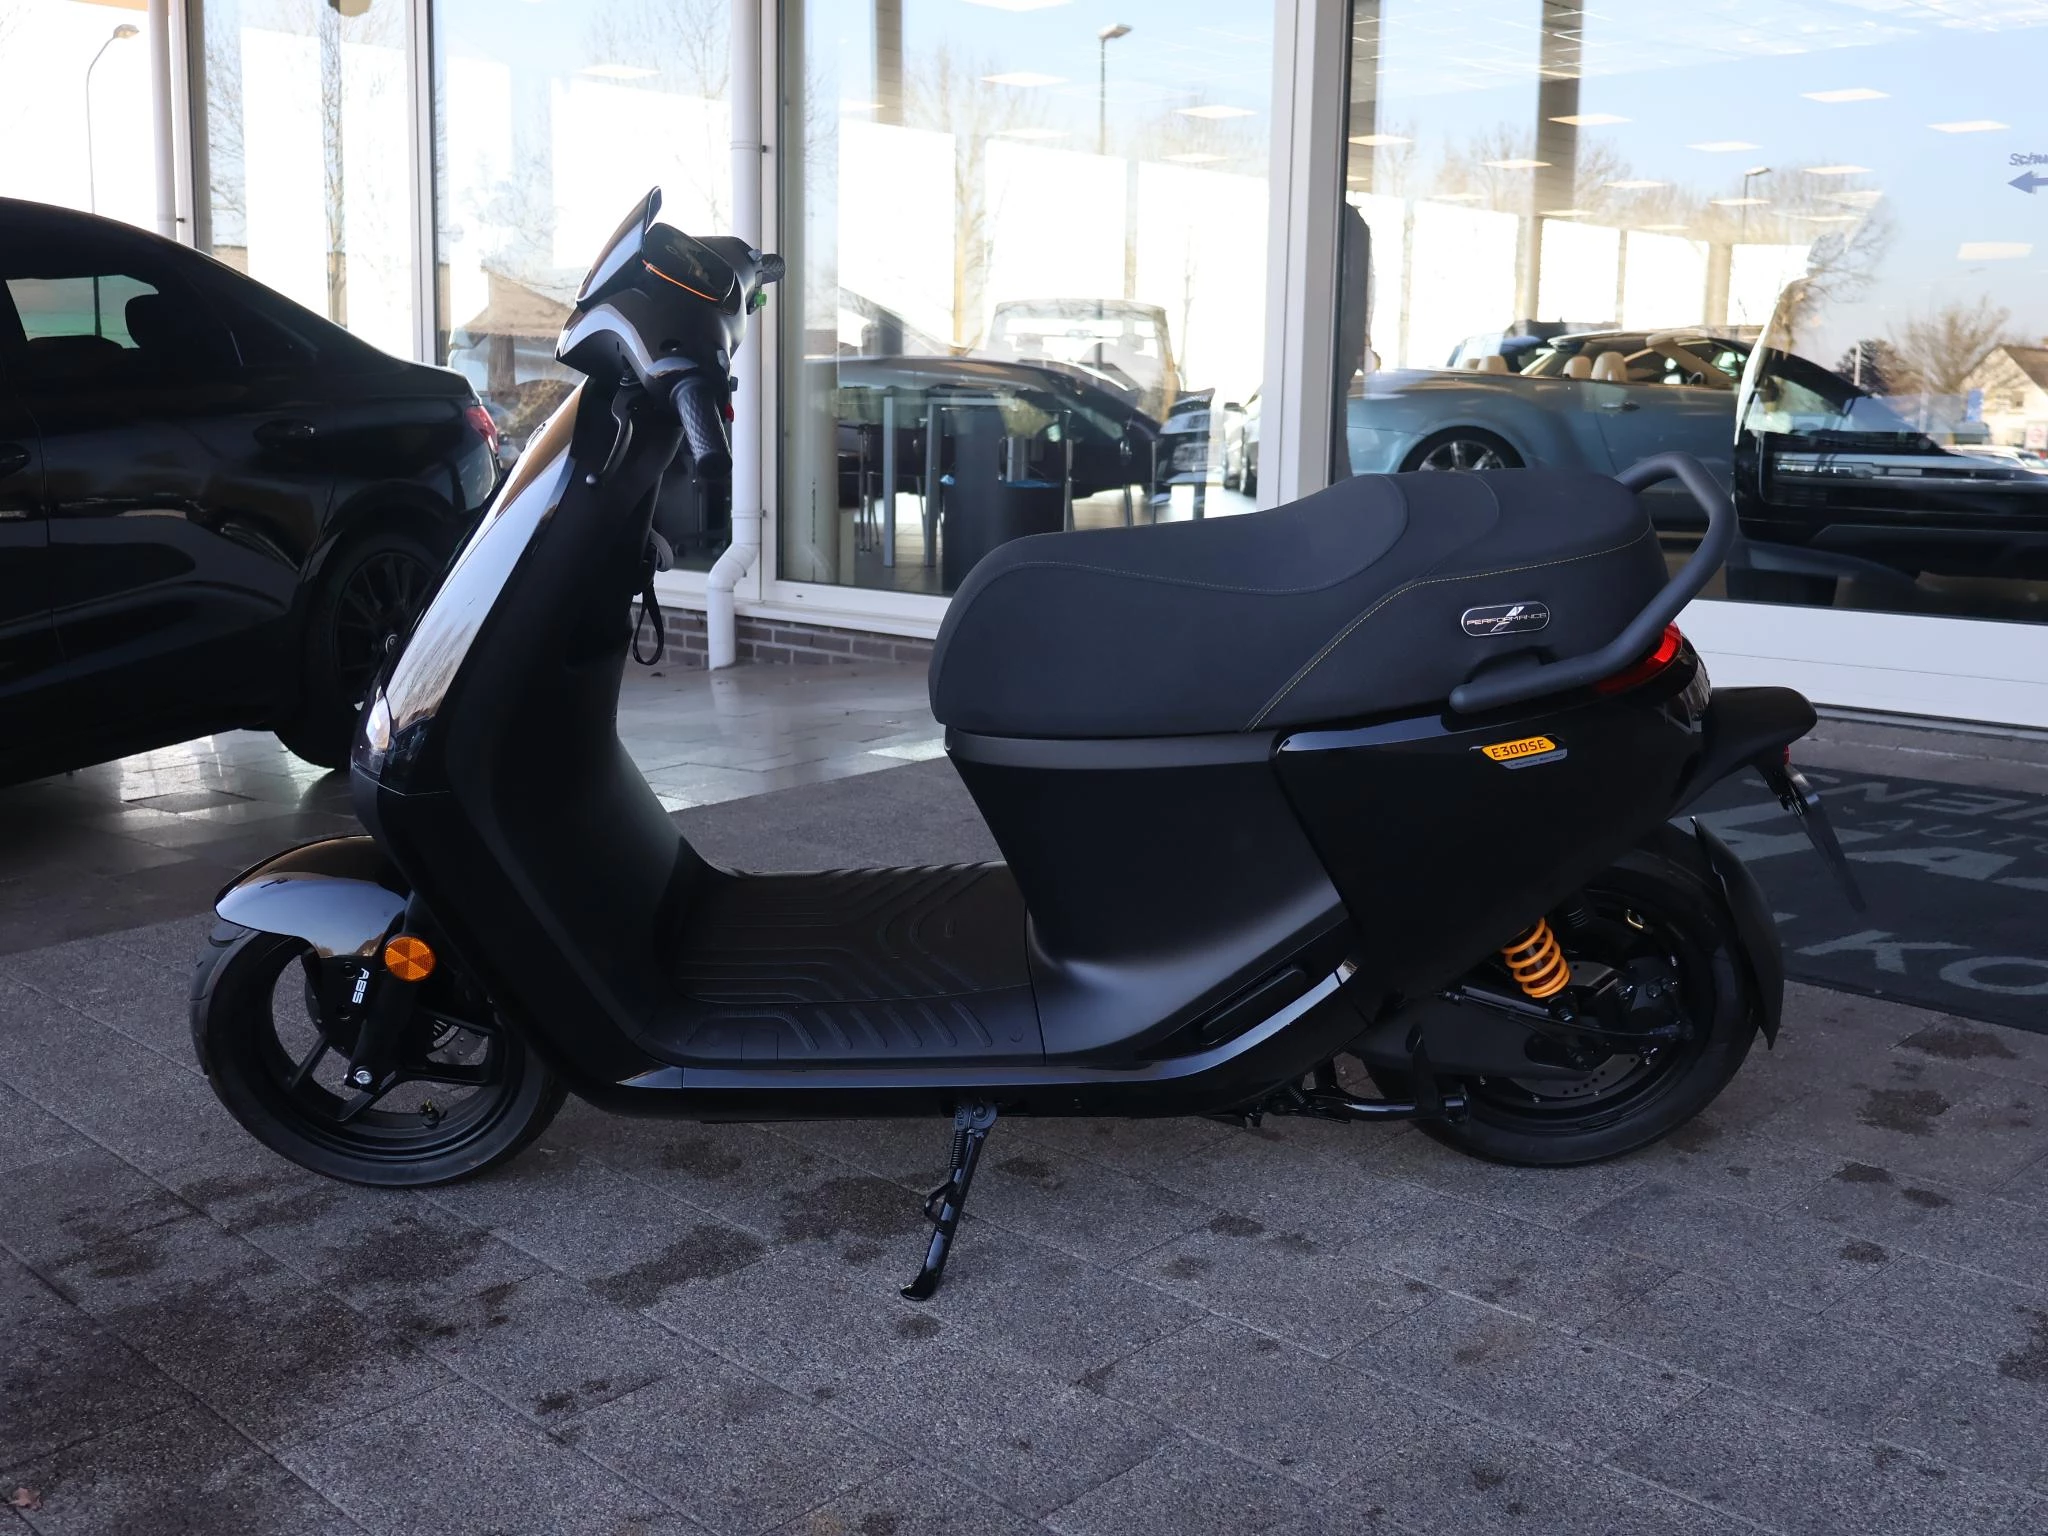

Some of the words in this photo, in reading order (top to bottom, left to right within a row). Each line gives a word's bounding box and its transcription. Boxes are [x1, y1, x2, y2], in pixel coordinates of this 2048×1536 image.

[1466, 612, 1548, 626] PERFORMANCE
[1491, 739, 1547, 759] E300SE
[352, 967, 370, 1005] ABS
